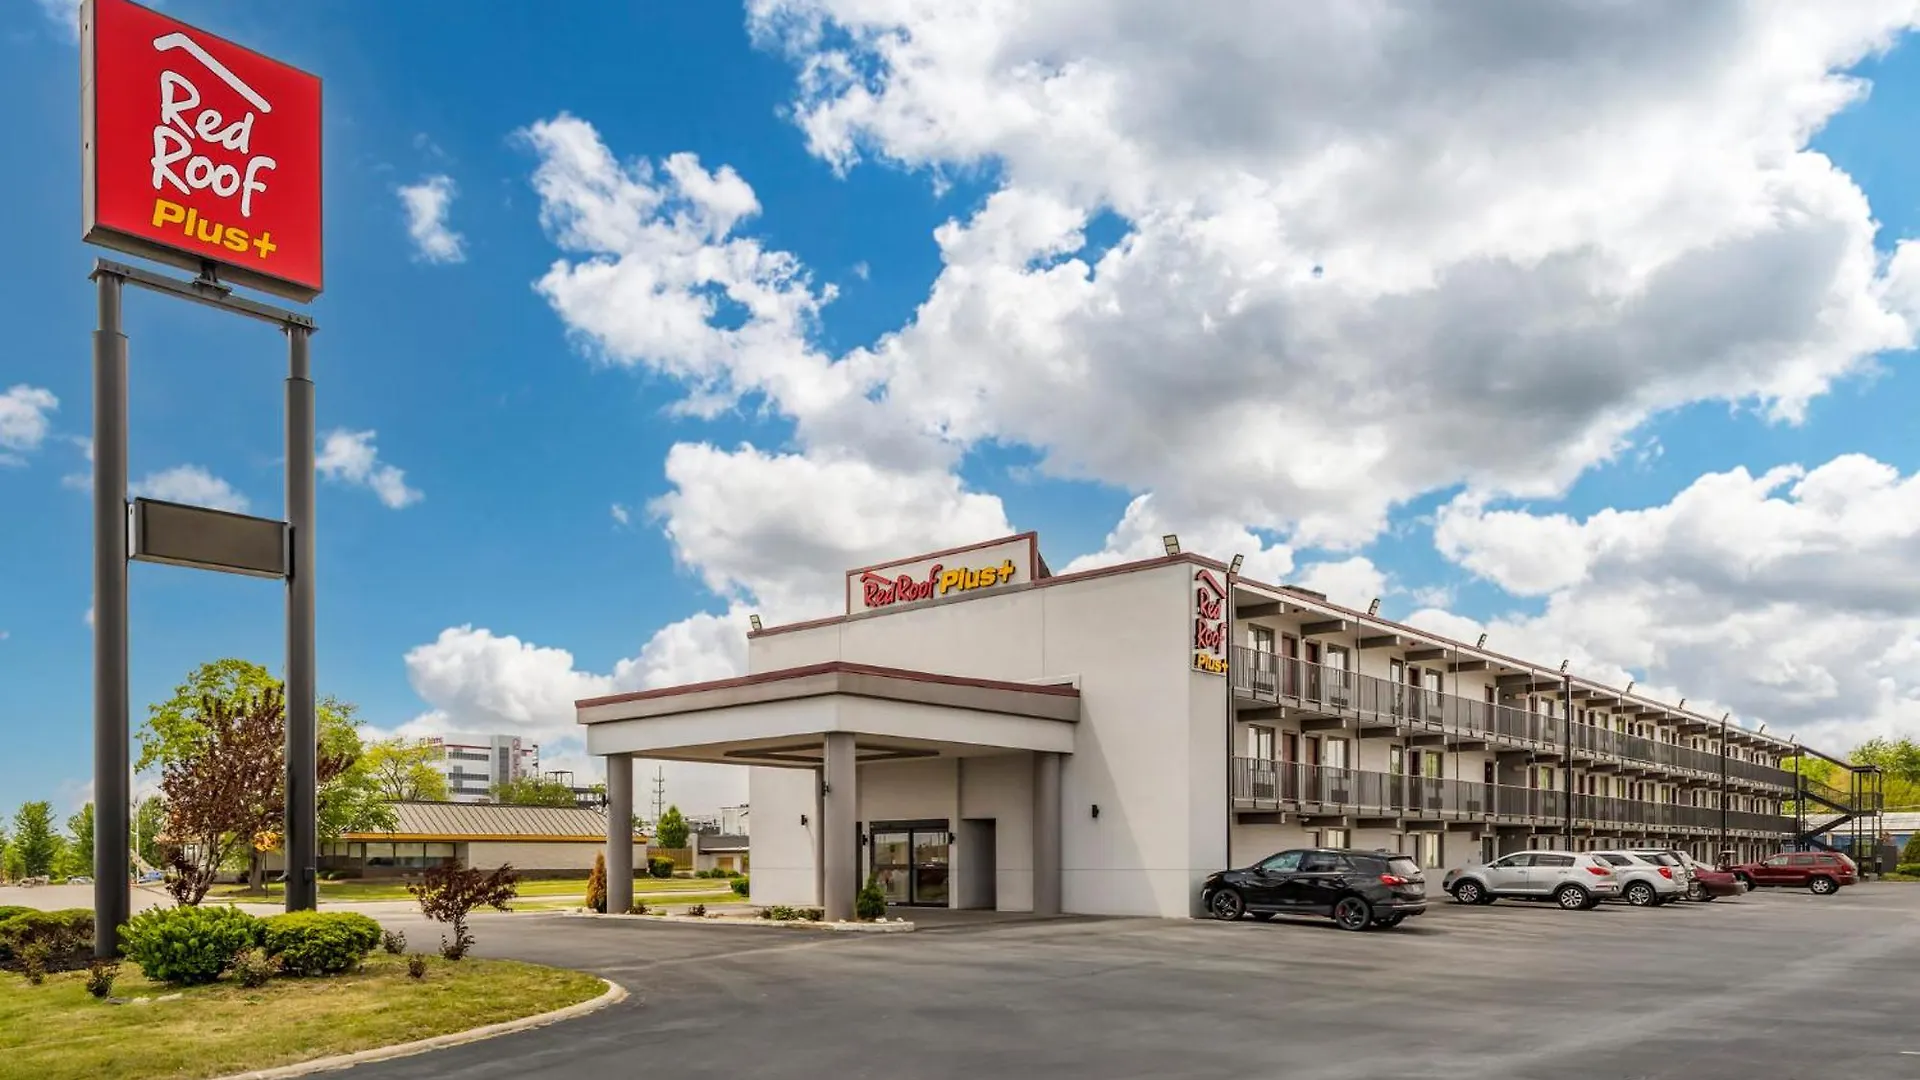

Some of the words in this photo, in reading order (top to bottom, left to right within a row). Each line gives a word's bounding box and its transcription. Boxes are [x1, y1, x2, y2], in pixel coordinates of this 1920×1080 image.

[160, 70, 254, 154] Red
[151, 125, 276, 217] Roof
[152, 199, 276, 259] Plus+
[863, 580, 898, 608] Red
[897, 564, 943, 601] Roof
[939, 559, 1016, 594] Plus+
[1197, 587, 1221, 619] Red
[1195, 618, 1228, 654] Roof
